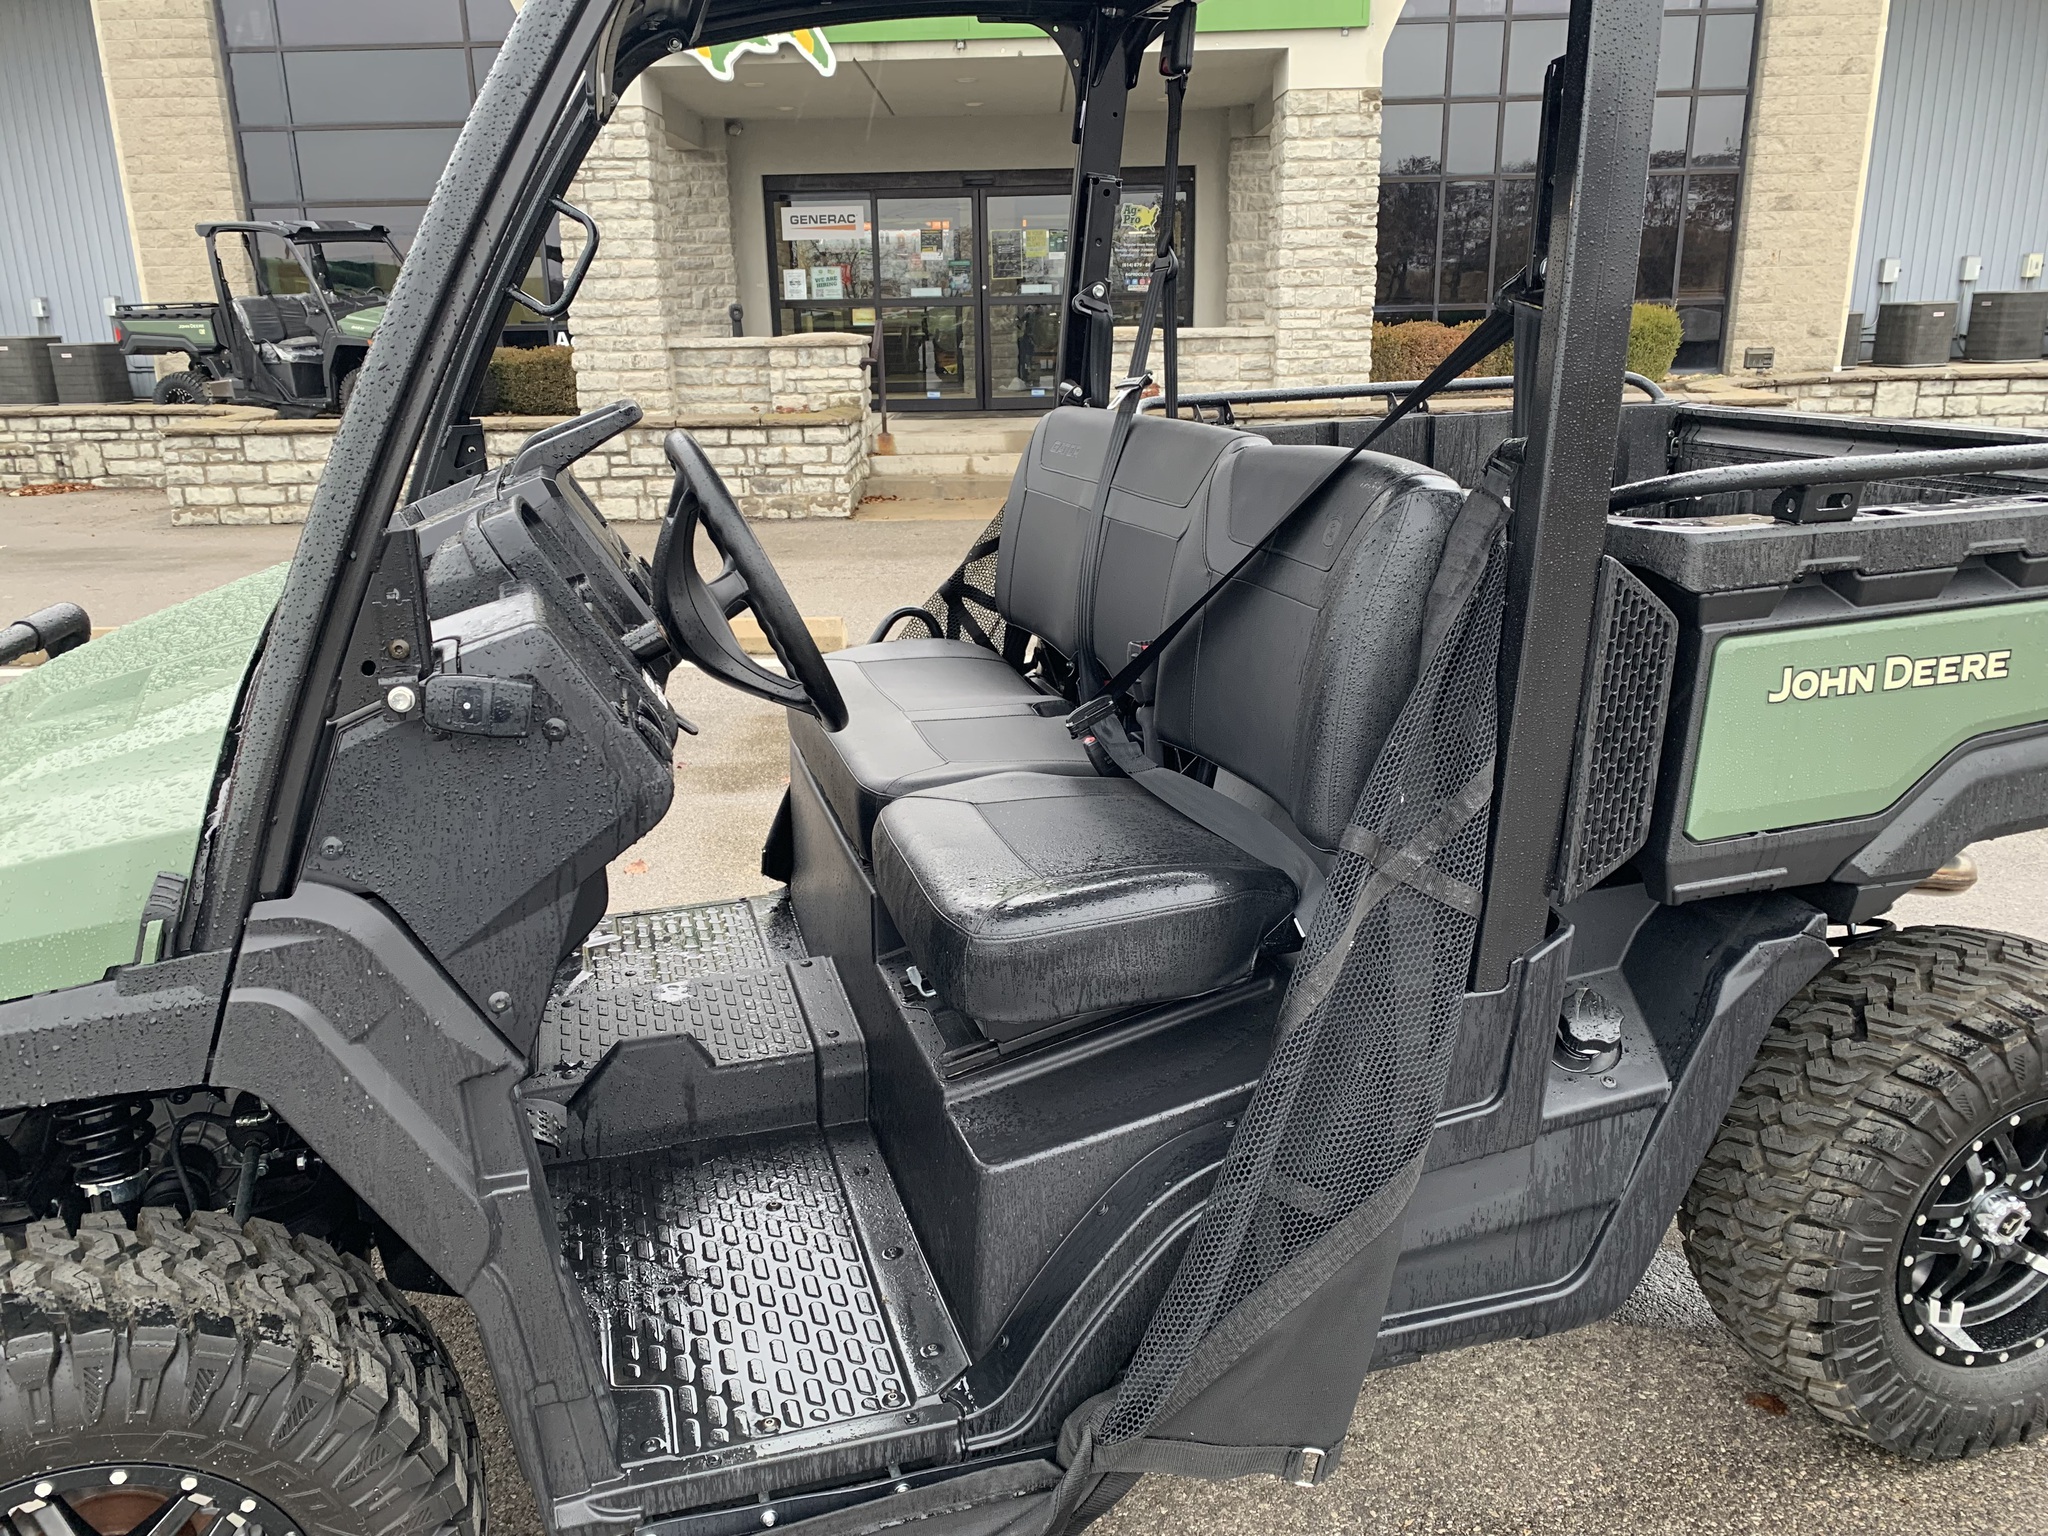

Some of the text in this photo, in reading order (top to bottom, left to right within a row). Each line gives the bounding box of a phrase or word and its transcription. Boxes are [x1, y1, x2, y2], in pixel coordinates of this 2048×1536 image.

[1123, 204, 1142, 216] Ag-
[790, 214, 856, 225] GENERAC
[1123, 214, 1141, 224] Pro
[1049, 440, 1081, 458] GATOR
[1767, 649, 2012, 704] JOHN DEERE
